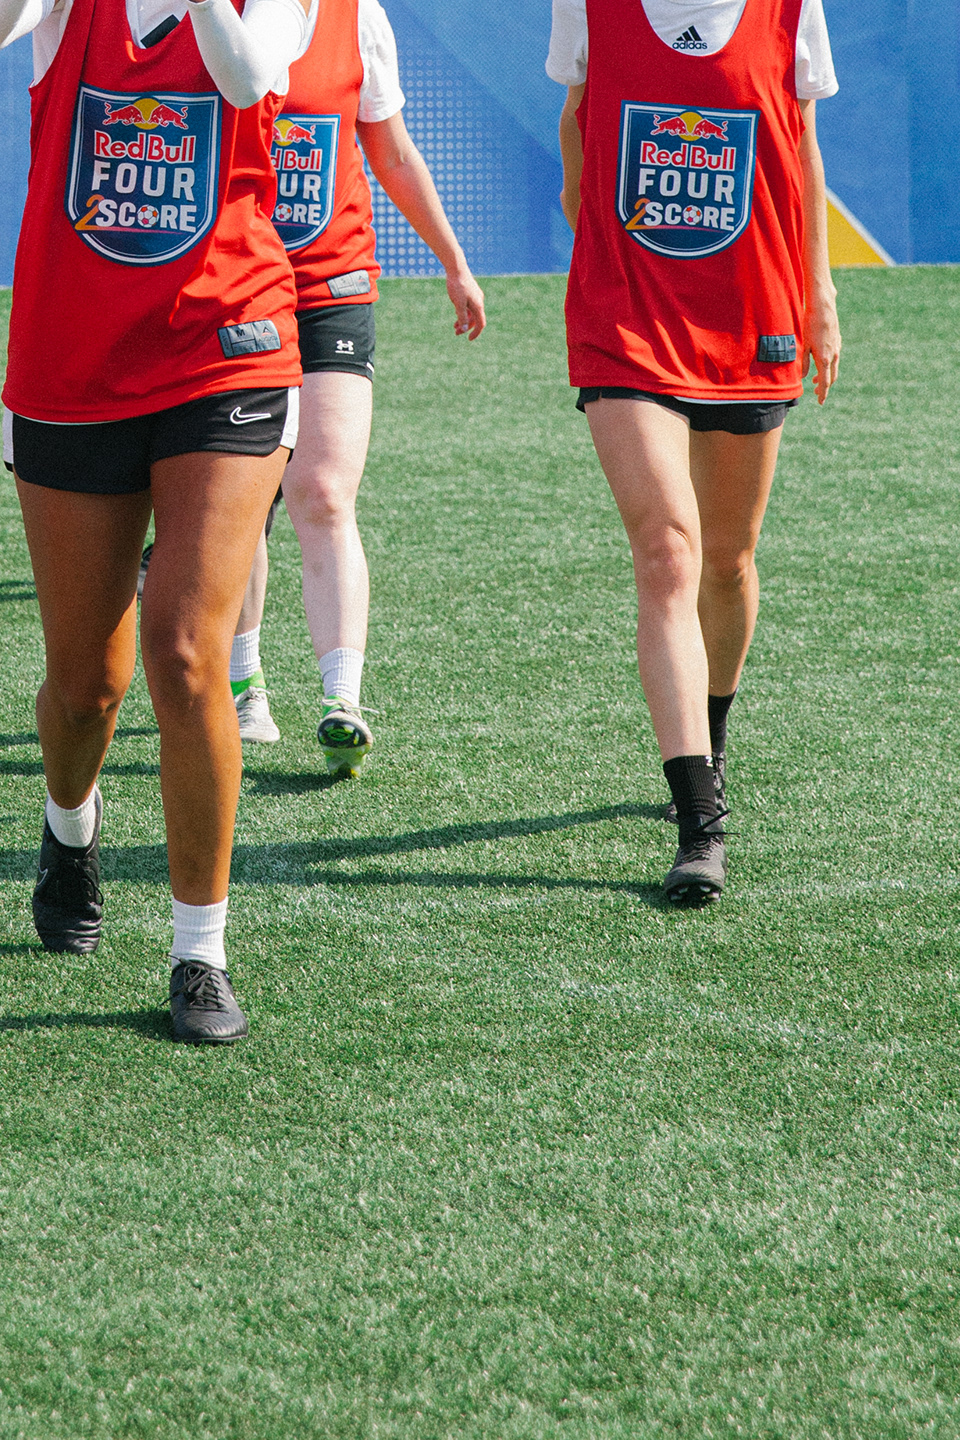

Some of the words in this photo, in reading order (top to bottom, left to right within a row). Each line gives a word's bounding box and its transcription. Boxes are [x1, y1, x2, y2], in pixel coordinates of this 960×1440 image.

[672, 40, 707, 50] adidas
[94, 130, 146, 160] Red
[147, 134, 196, 164] Bull
[282, 149, 322, 171] Bull
[640, 140, 689, 167] Red
[689, 146, 736, 171] Bull
[91, 160, 195, 202] FOUR
[280, 173, 321, 202] UR
[638, 168, 735, 205] FOUR
[236, 329, 246, 338] M
